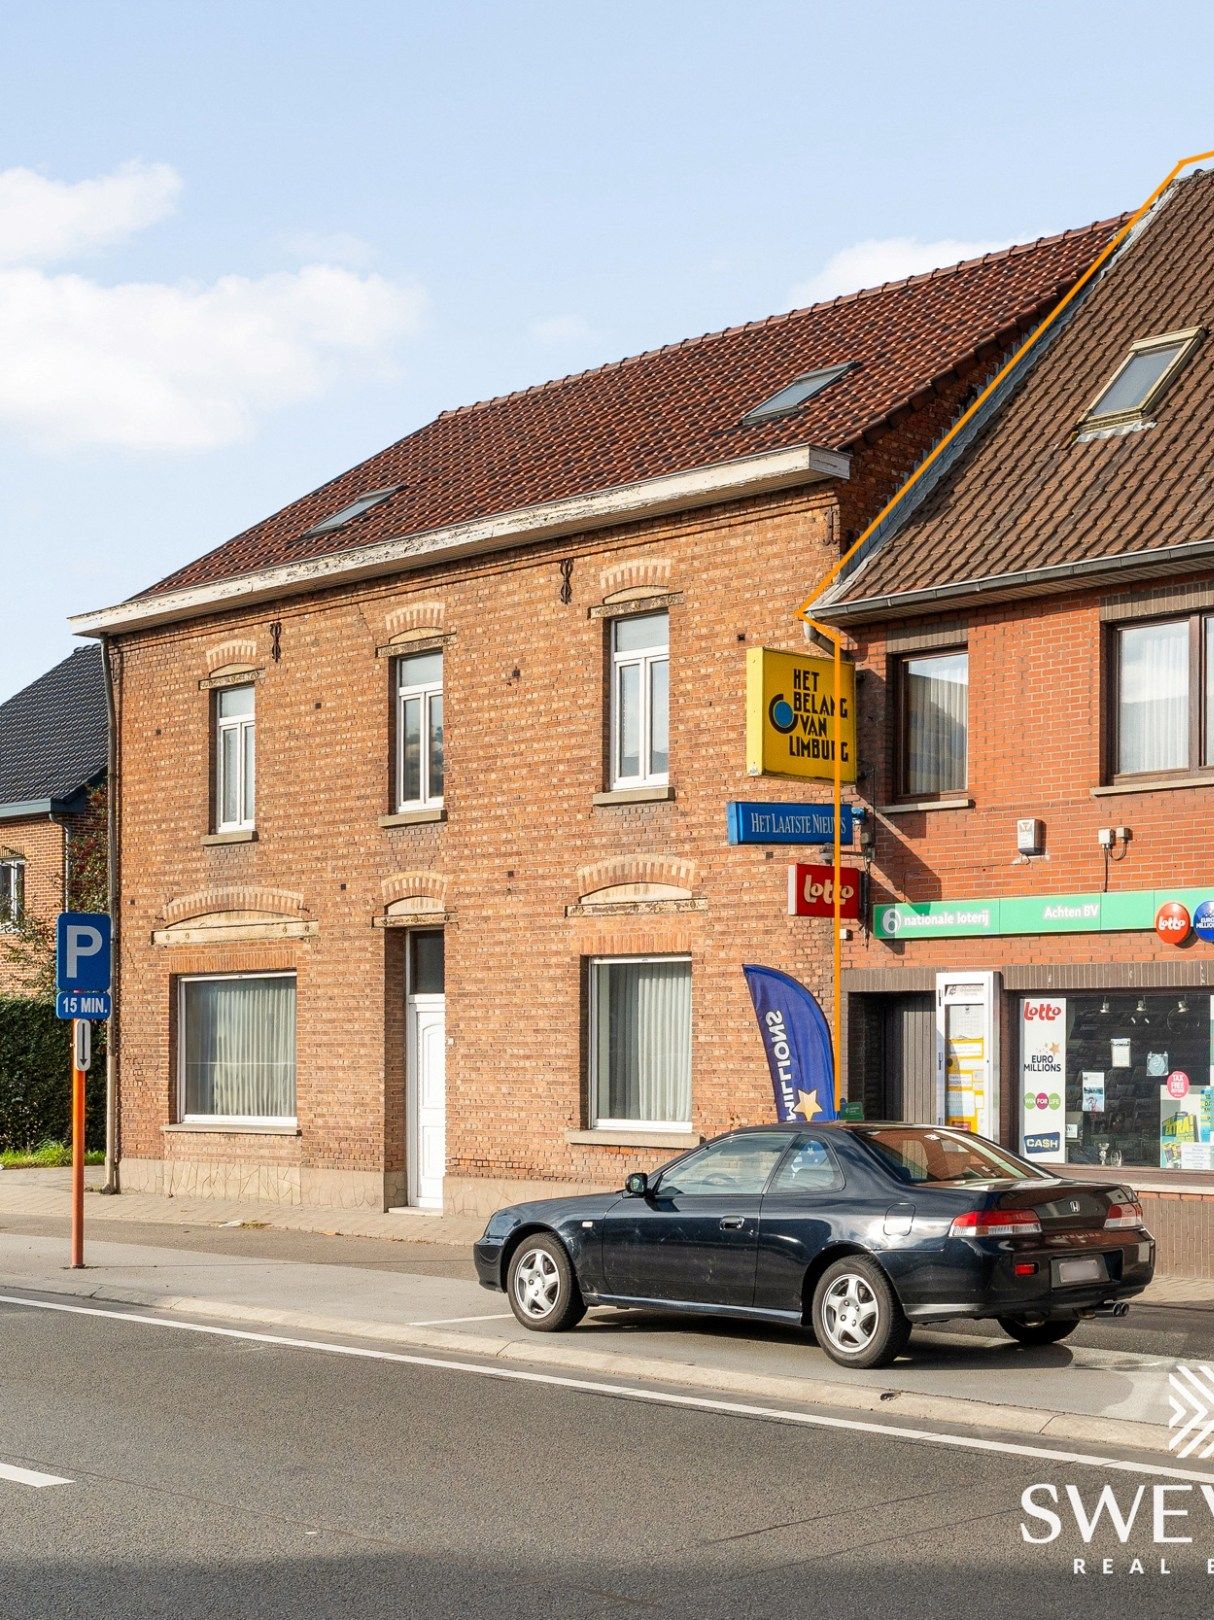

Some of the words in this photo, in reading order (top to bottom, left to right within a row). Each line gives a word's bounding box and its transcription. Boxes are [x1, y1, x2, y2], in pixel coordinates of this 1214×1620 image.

[794, 668, 819, 692] HET
[800, 713, 828, 738] VAN
[750, 812, 770, 833] HET
[771, 813, 811, 834] LAATSTE
[811, 814, 847, 834] NIEUS
[904, 911, 954, 926] nationale
[956, 910, 989, 927] loterij
[1044, 906, 1081, 918] Achten
[66, 925, 103, 978] P
[63, 997, 78, 1013] 15
[81, 997, 108, 1013] MIN.
[1023, 1063, 1062, 1072] MILLIONS
[1031, 1054, 1053, 1064] EURO
